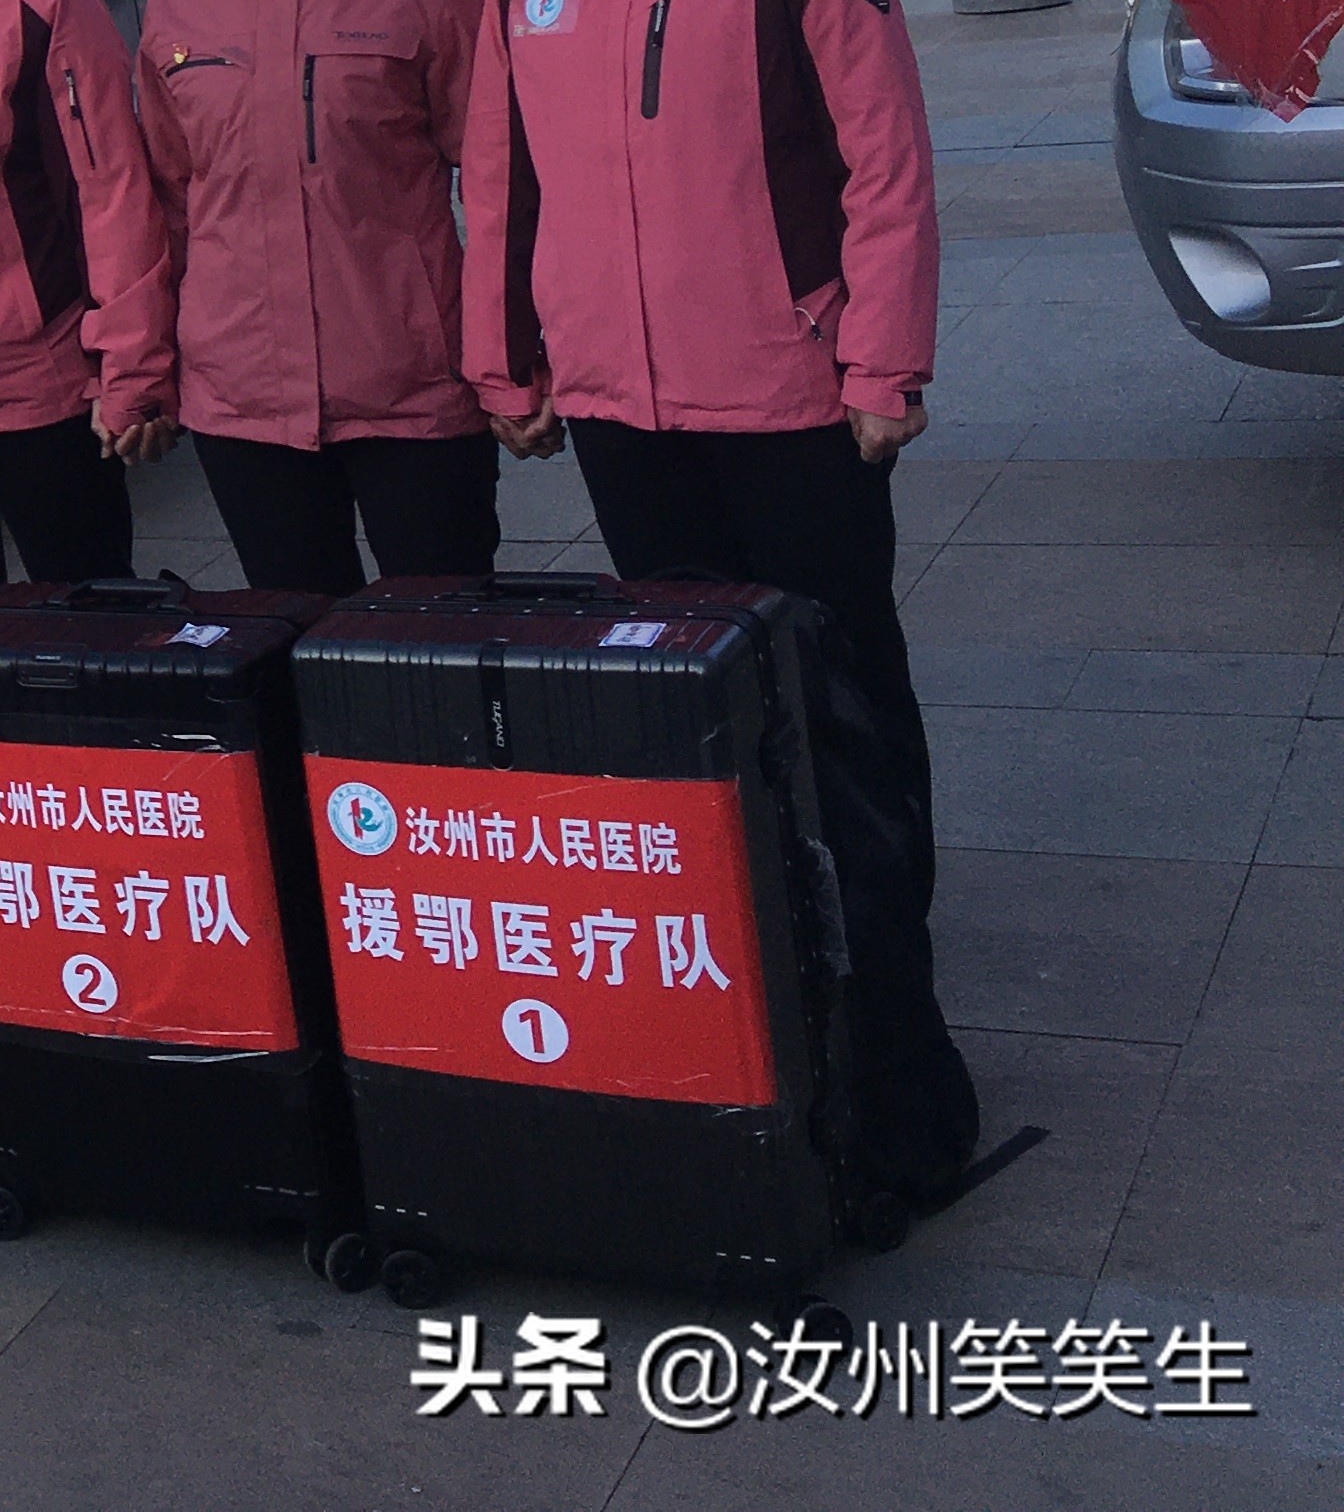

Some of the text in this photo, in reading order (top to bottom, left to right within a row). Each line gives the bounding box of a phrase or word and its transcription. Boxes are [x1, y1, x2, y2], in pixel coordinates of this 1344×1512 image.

[405, 806, 682, 875] 汝州市人民医院
[339, 882, 731, 991] 援鄂医疗队
